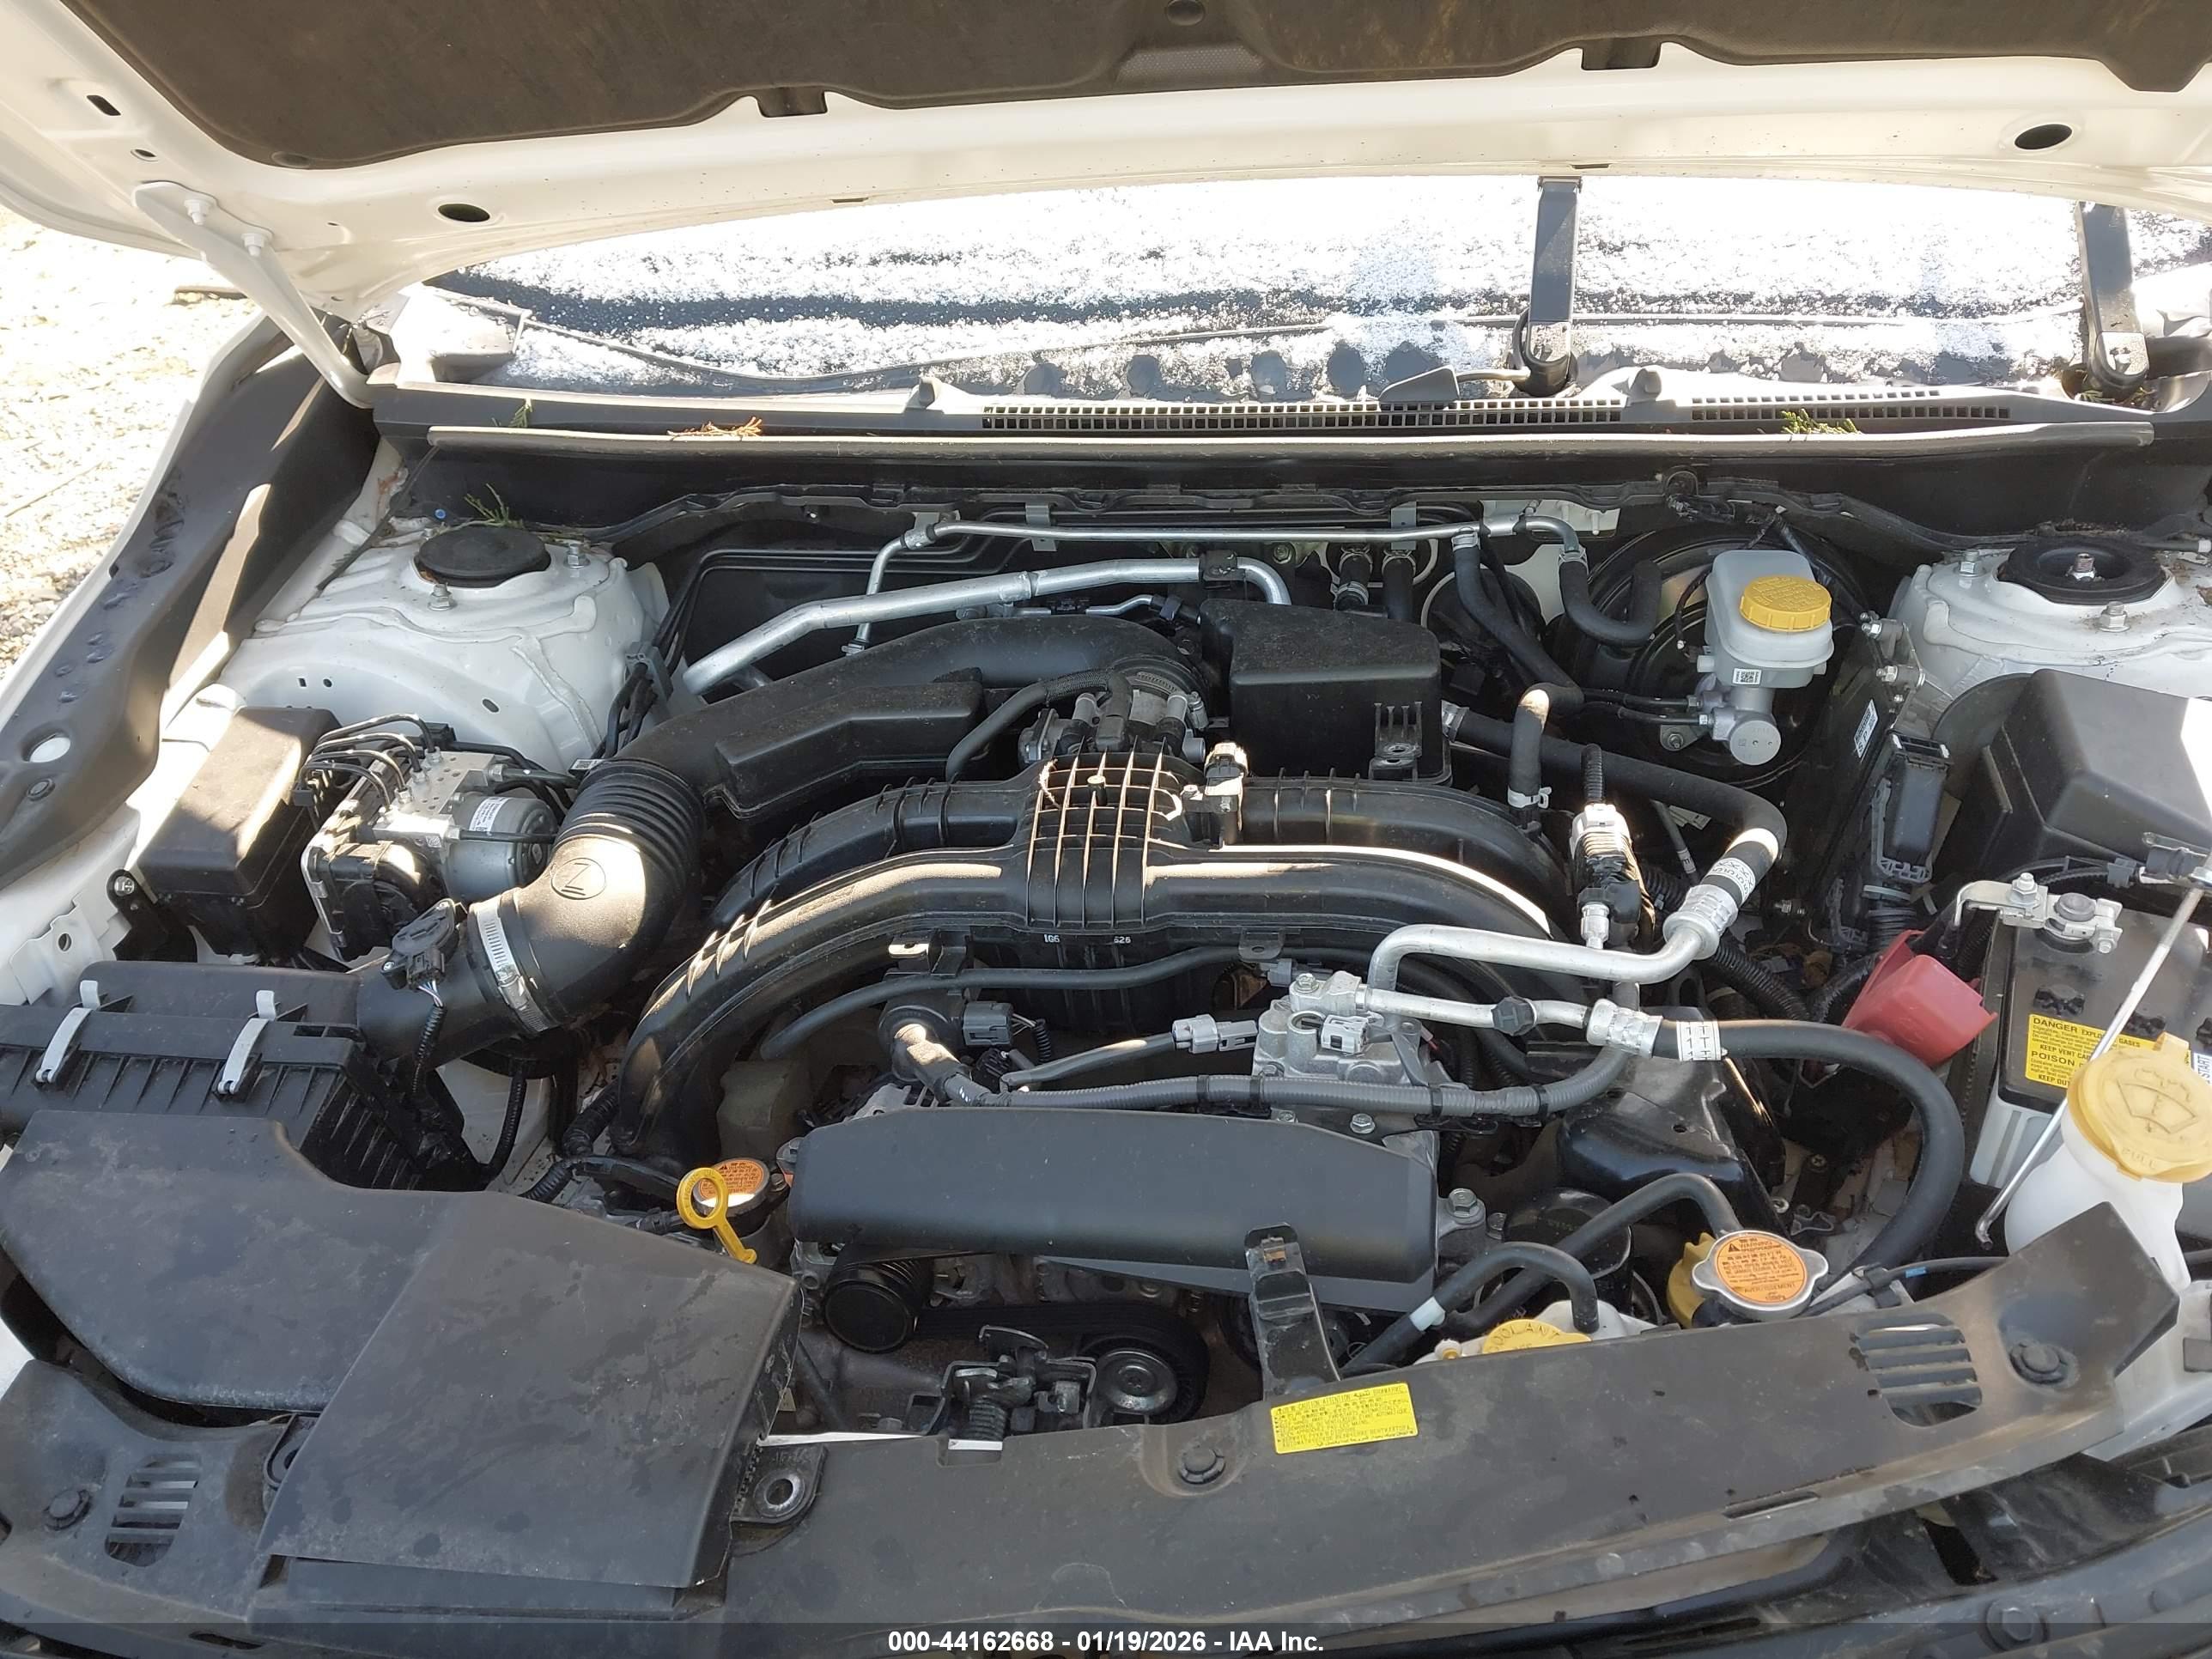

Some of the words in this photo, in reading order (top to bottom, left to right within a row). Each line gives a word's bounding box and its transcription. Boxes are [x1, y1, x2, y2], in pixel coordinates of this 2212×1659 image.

[2033, 1018, 2078, 1034] DANGER
[2039, 1044, 2057, 1053] KEEP
[2031, 1050, 2075, 1066] POISON
[2038, 1073, 2056, 1082] KEEP
